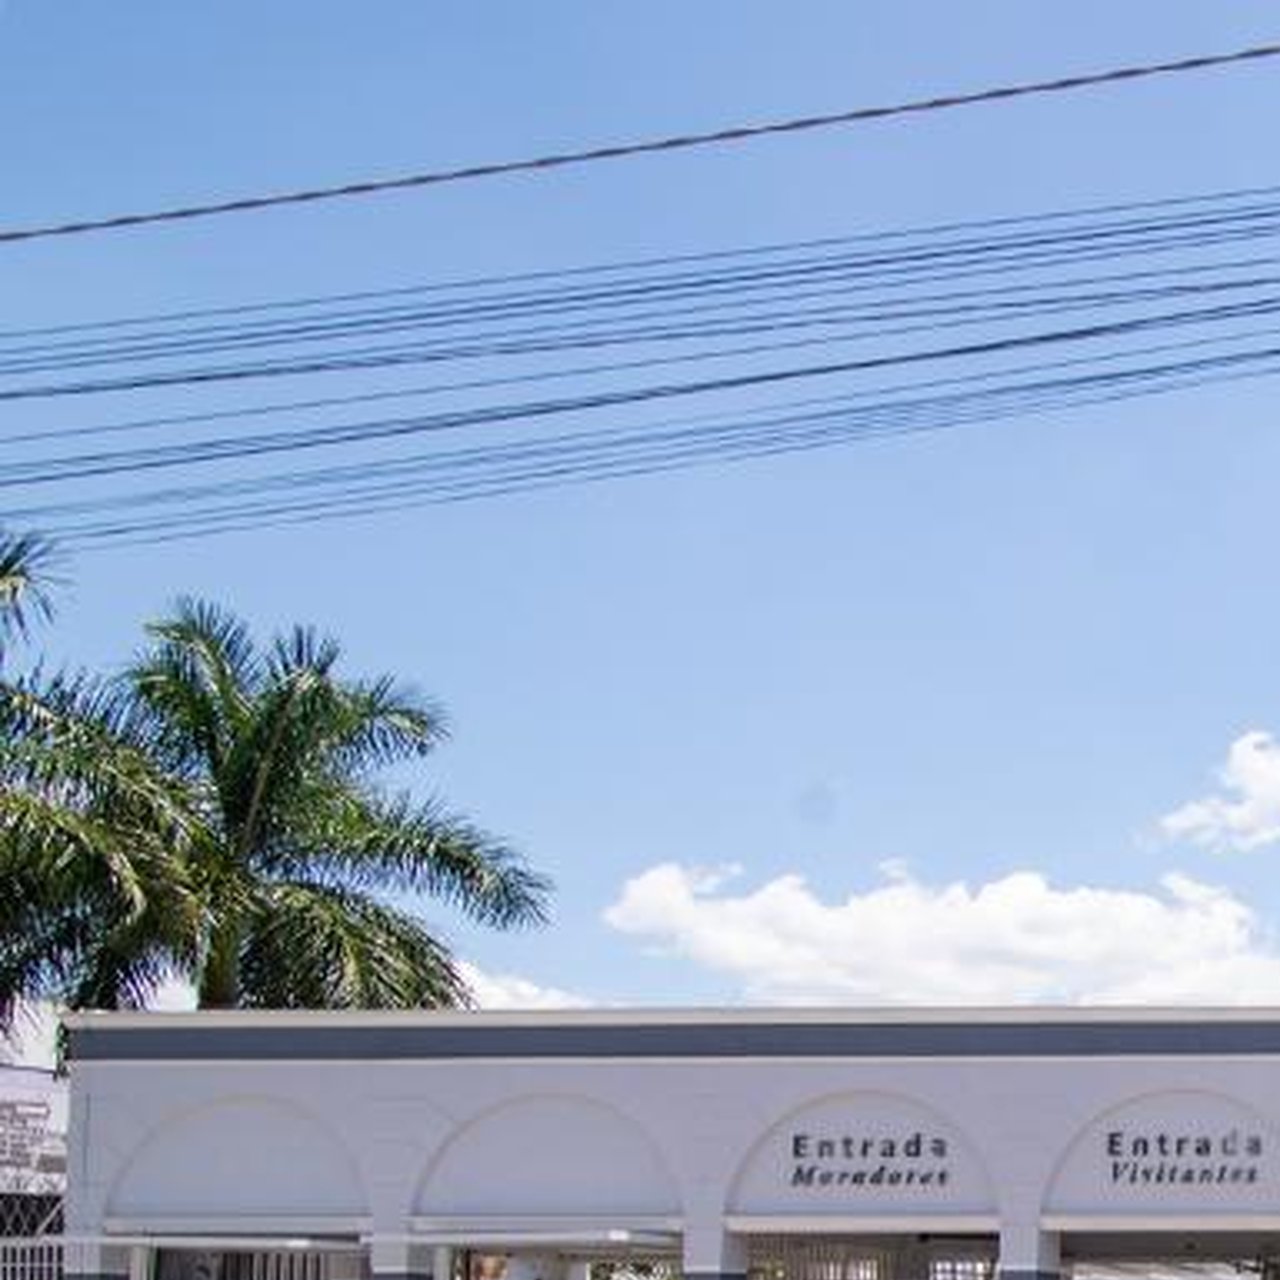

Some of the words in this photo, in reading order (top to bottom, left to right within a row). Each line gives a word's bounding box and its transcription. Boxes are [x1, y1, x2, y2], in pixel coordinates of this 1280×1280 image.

[792, 1132, 948, 1159] Entrada
[1106, 1129, 1263, 1157] Entrada
[791, 1164, 949, 1187] Moradores
[1111, 1161, 1258, 1184] Visitantes
